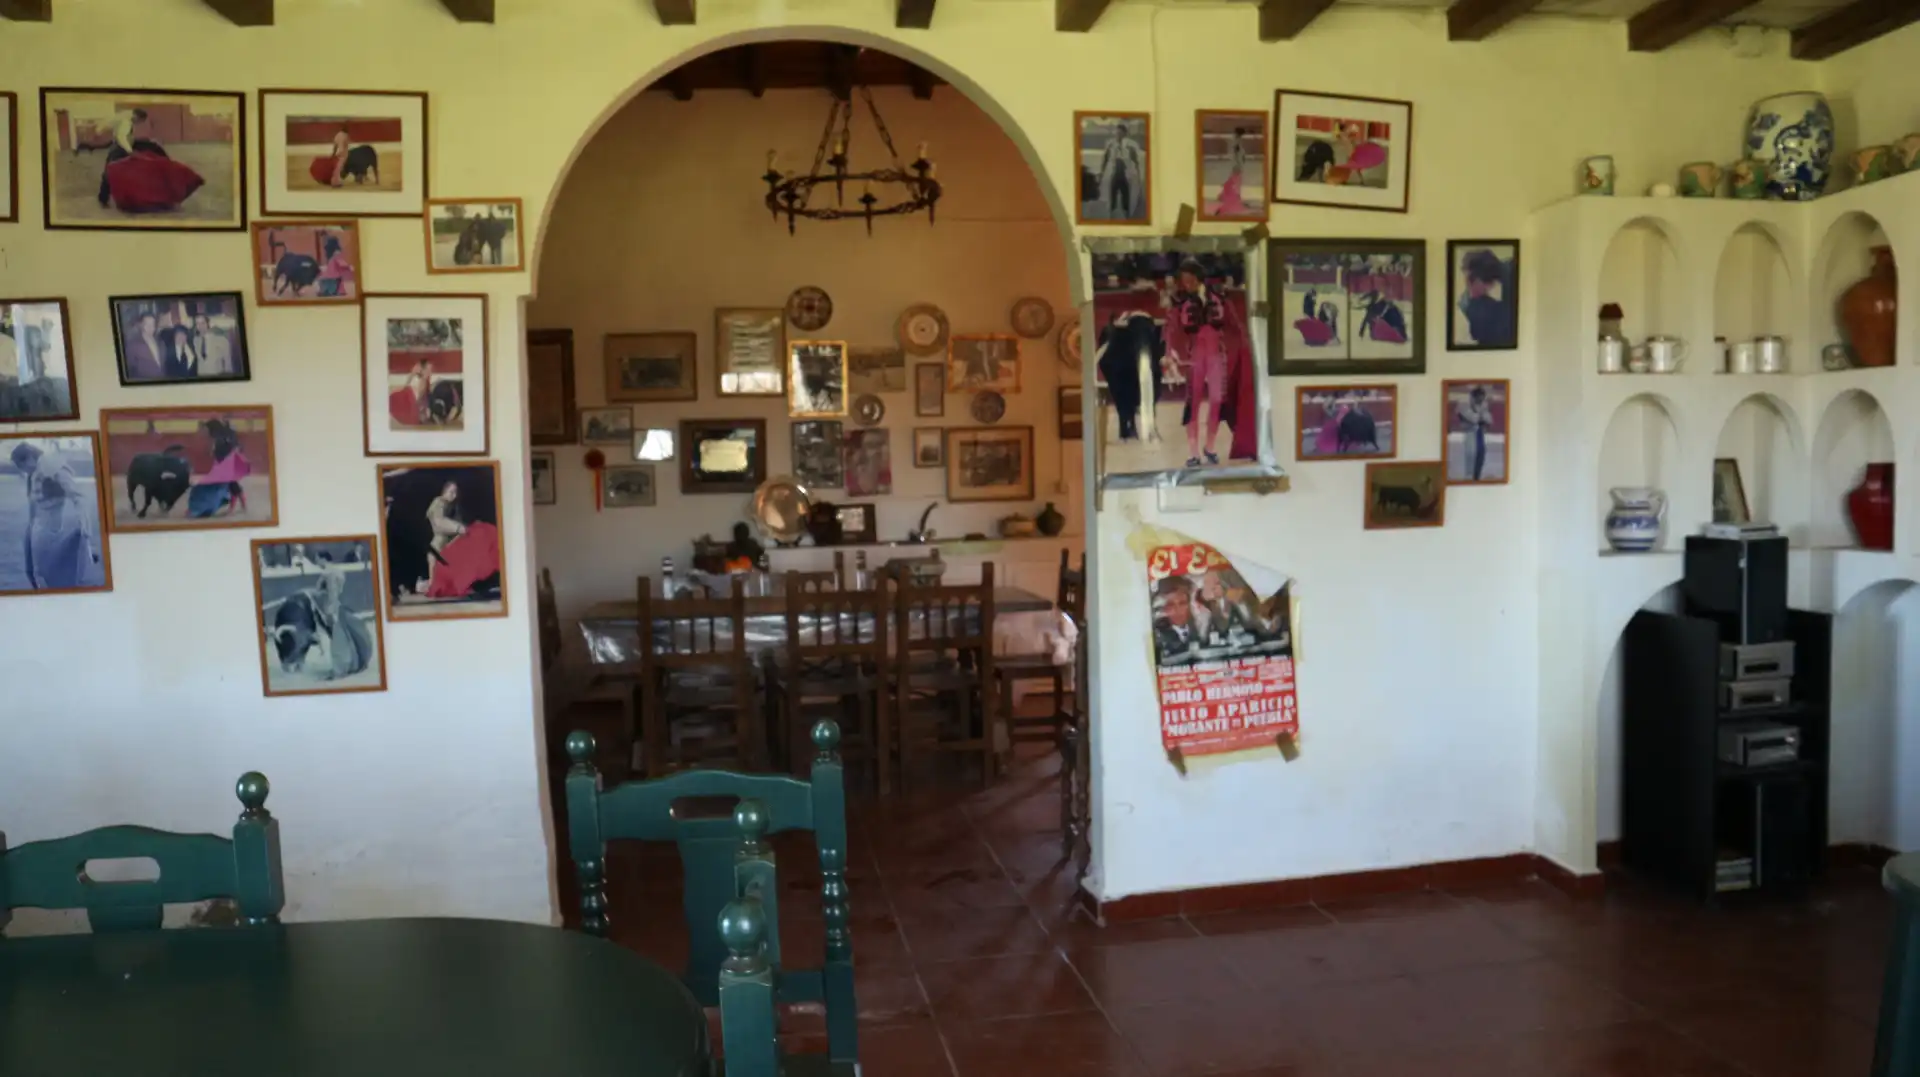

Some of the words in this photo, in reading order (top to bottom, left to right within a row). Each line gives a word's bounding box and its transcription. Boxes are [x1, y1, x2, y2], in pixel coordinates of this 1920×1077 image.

[1151, 549, 1178, 579] El
[1164, 706, 1208, 725] JULIO
[1216, 695, 1294, 718] APARICIO
[1167, 718, 1230, 737] MORANTE
